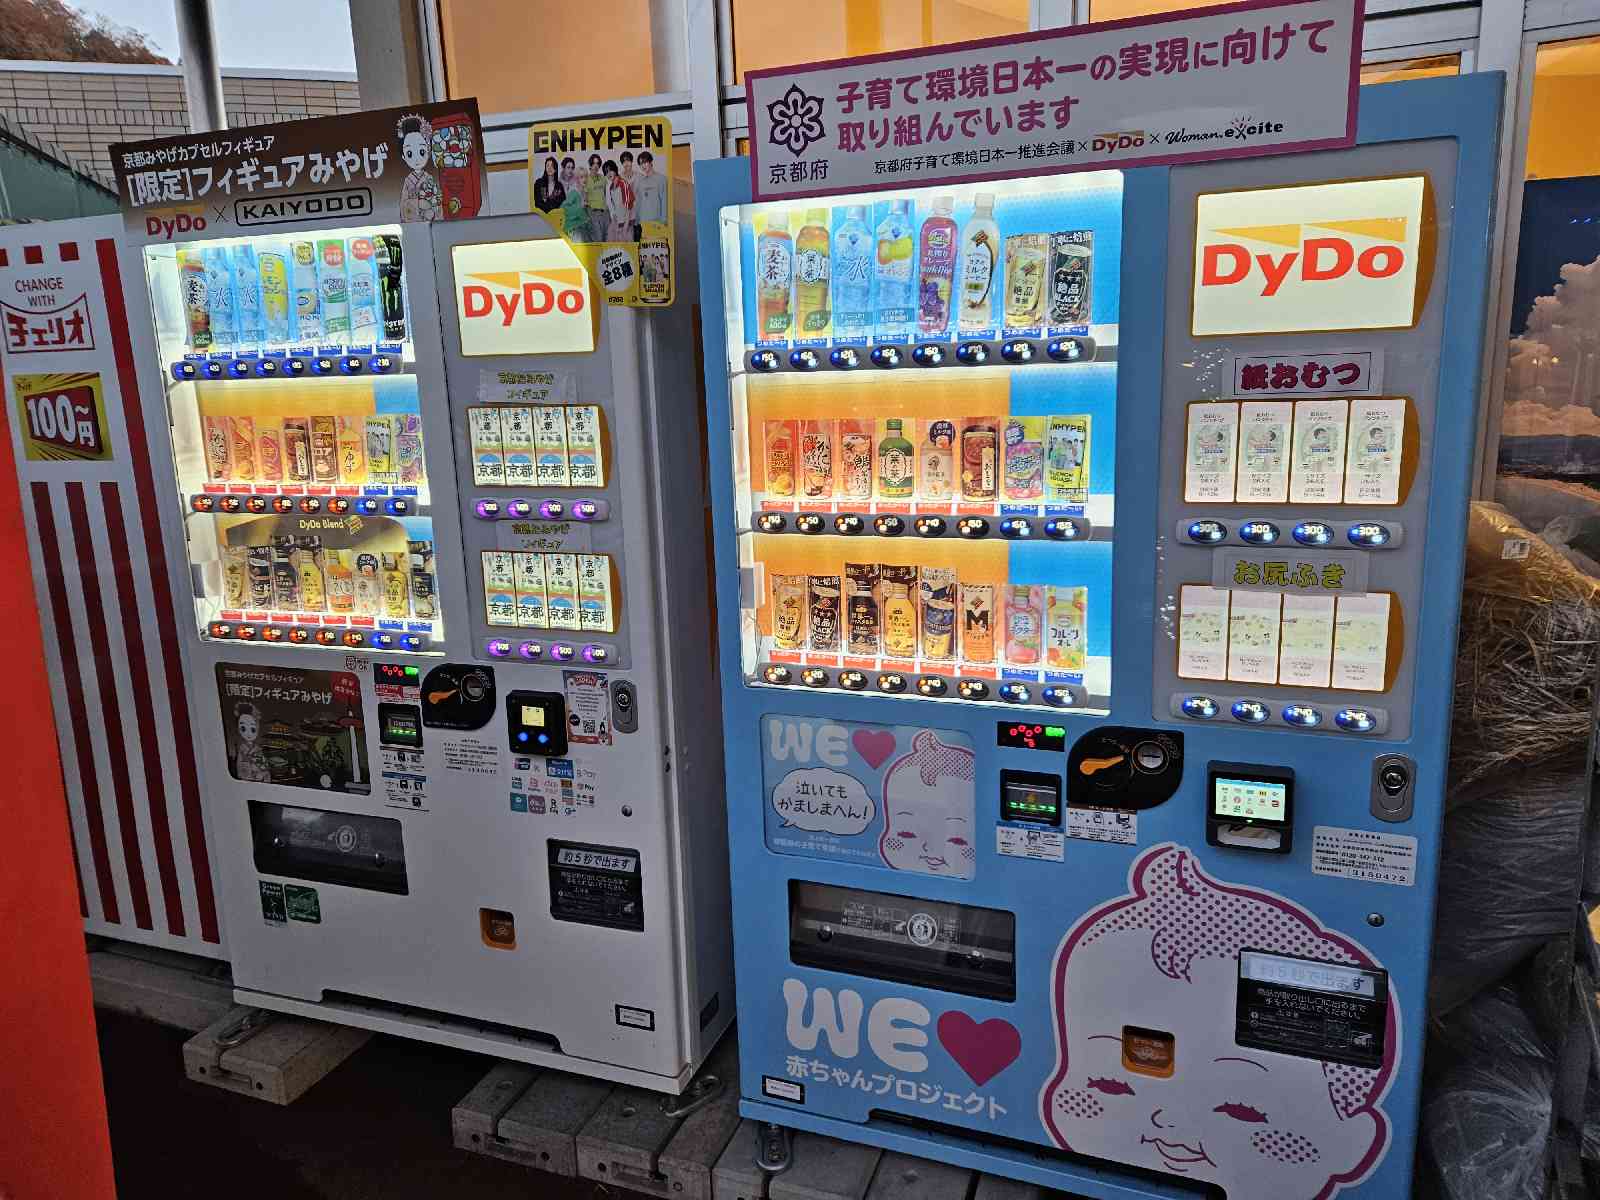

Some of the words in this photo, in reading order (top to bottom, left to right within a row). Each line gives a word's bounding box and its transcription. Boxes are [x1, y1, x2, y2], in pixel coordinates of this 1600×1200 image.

[836, 19, 1337, 114] 子育て環境日本一の実現に向けて
[533, 124, 664, 153] ENHYPEN
[838, 97, 1080, 152] 取り組んでいます
[121, 135, 275, 168] 京都みやげカプセルフィギュア
[1092, 133, 1145, 154] DyDo
[126, 142, 389, 207] [限定]フィギュアみやげ
[769, 161, 829, 184] 京都府
[145, 211, 207, 240] DyDo
[242, 195, 365, 219] KAIYODO
[1202, 238, 1405, 296] DyDo
[15, 277, 64, 293] CHANGE
[28, 295, 56, 307] WITH
[463, 282, 585, 326] DyDo
[6, 308, 86, 347] チェリオ
[1240, 361, 1361, 391] 紙おむつ
[478, 464, 503, 478] 京都
[507, 464, 534, 478] 京都
[538, 464, 565, 478] 京都
[571, 465, 597, 479] 京都
[1250, 524, 1270, 533] 300
[1233, 560, 1345, 588] お尻ふき
[769, 719, 849, 766] WE
[795, 781, 848, 799] 泣いても
[783, 978, 931, 1072] WE
[785, 1054, 1008, 1120] 赤ちゃんプロジェクト
